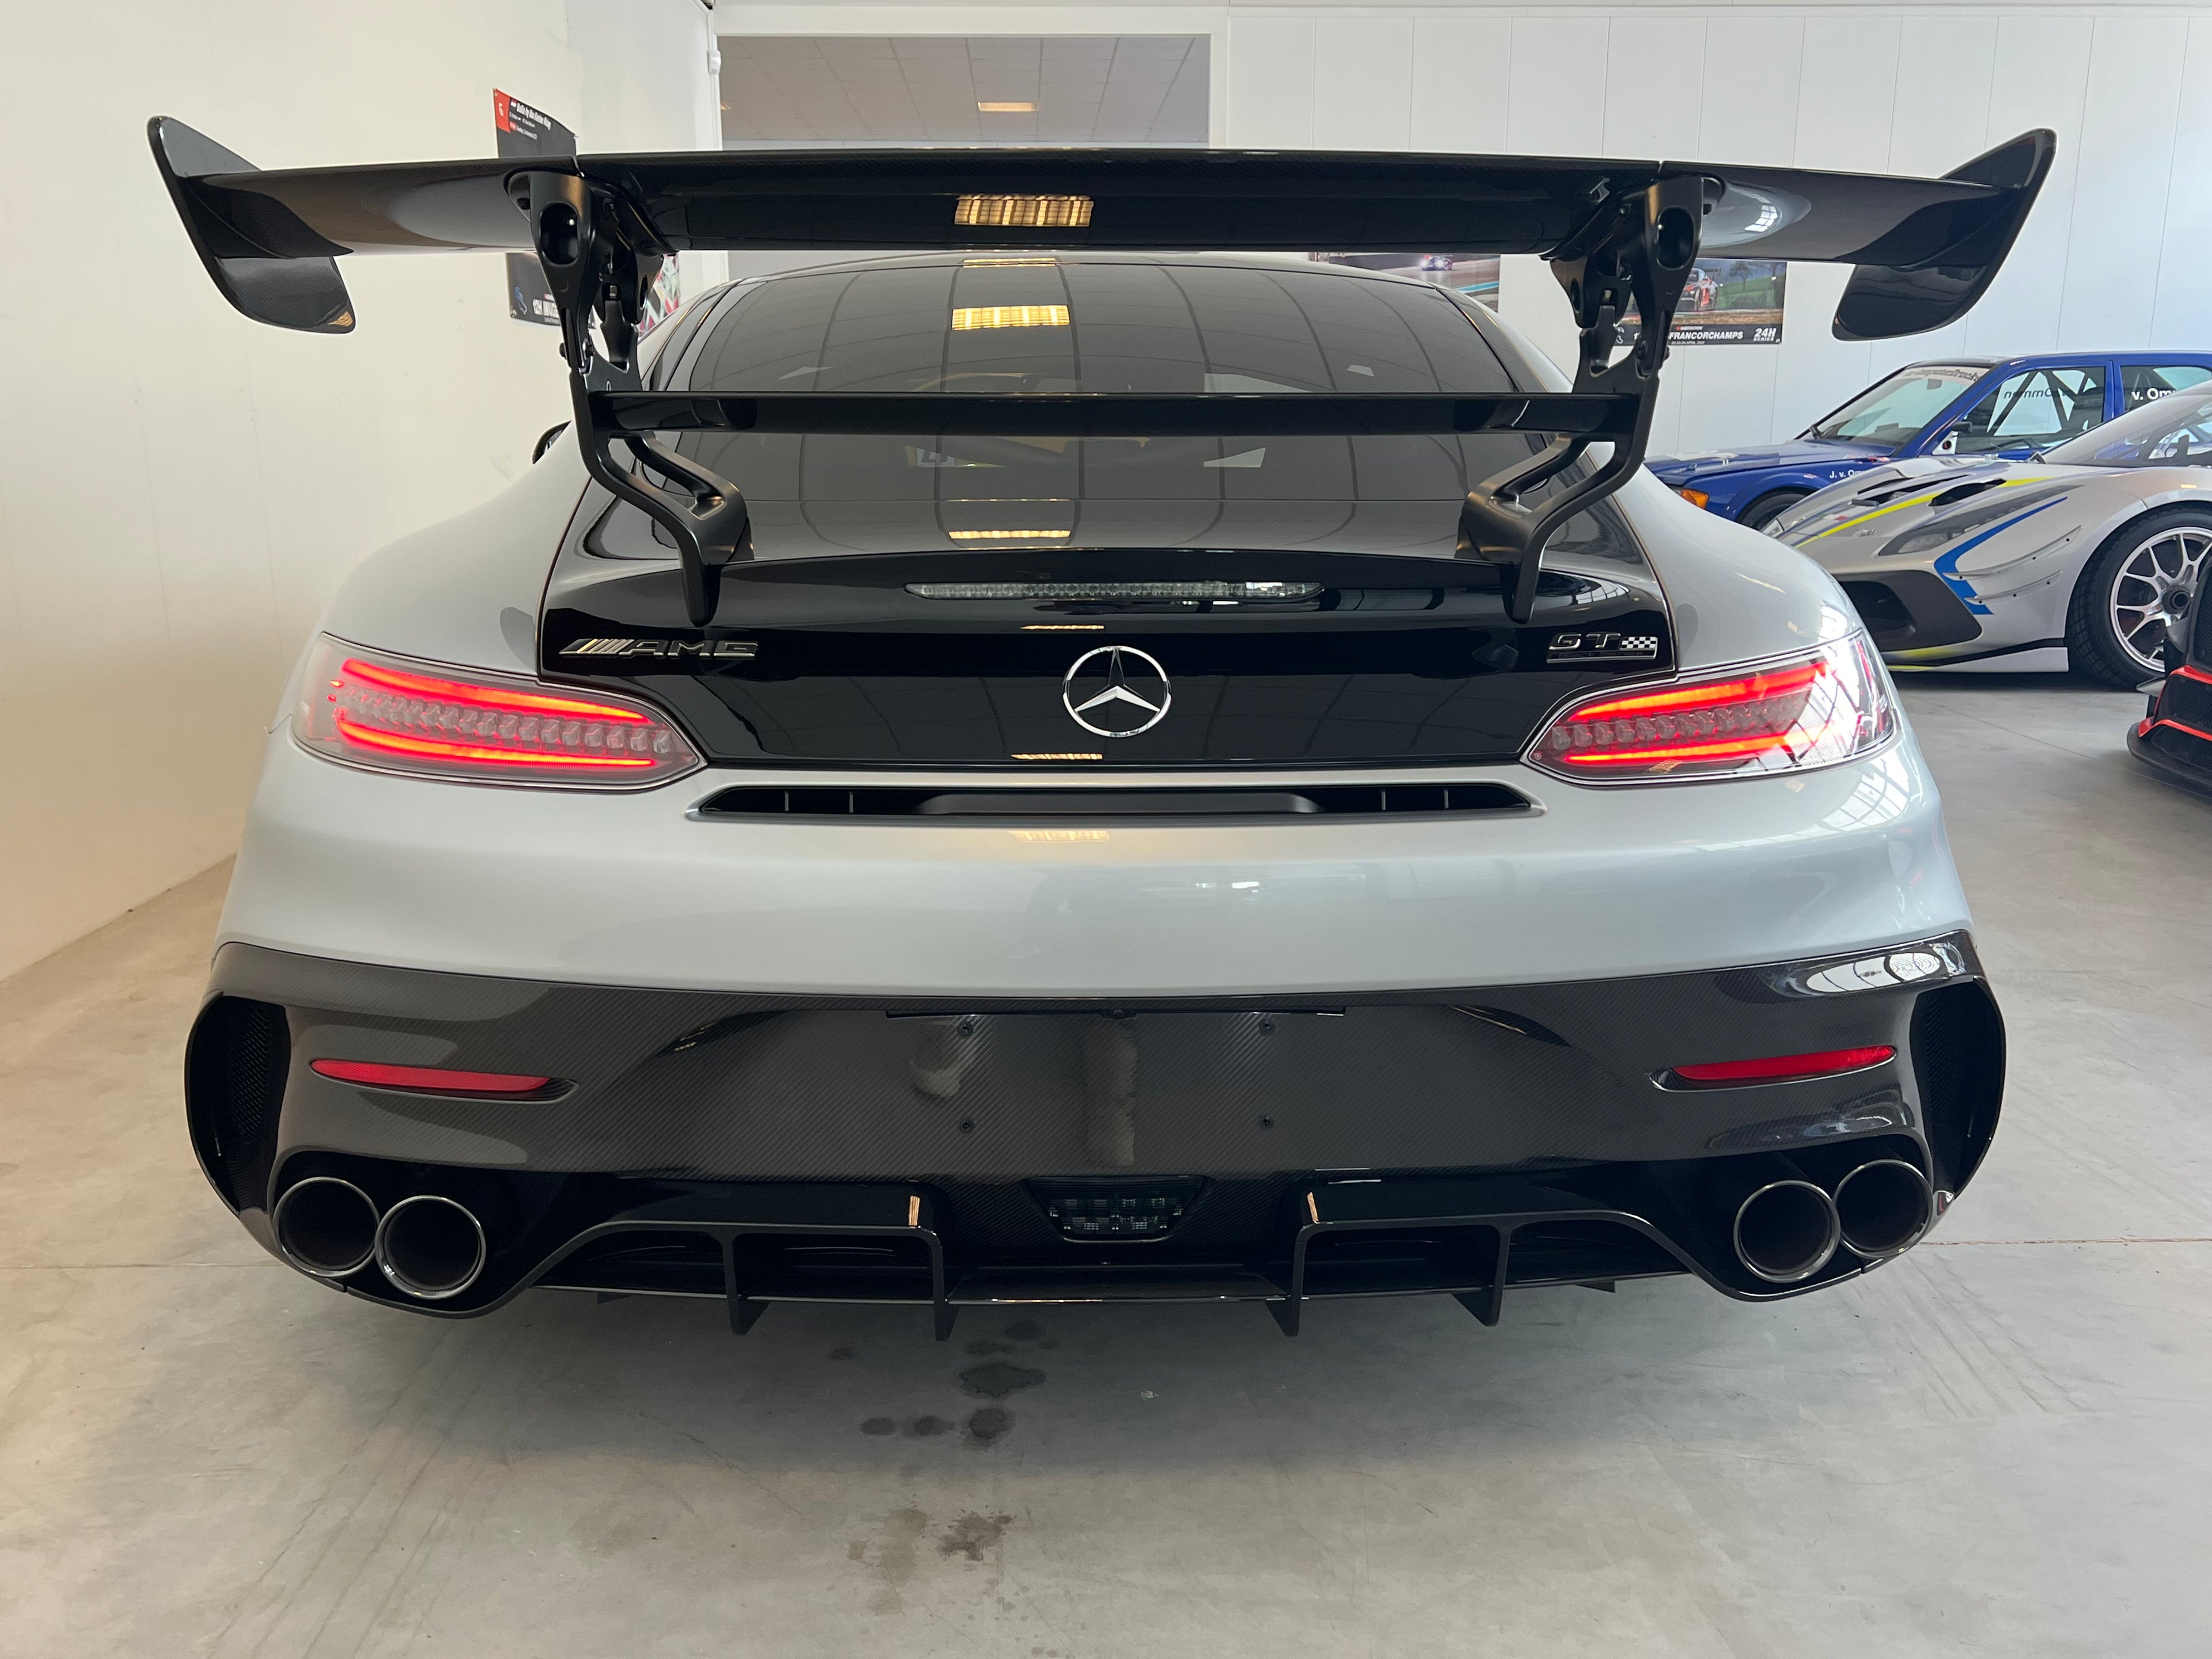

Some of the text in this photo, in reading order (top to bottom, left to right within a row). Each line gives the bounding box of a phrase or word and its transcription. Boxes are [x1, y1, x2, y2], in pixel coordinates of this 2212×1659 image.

[1754, 328, 1777, 337] 24H
[2131, 388, 2176, 400] v. Om
[1830, 471, 1838, 479] J.
[1548, 631, 1621, 650] GT
[618, 639, 759, 659] AMG
